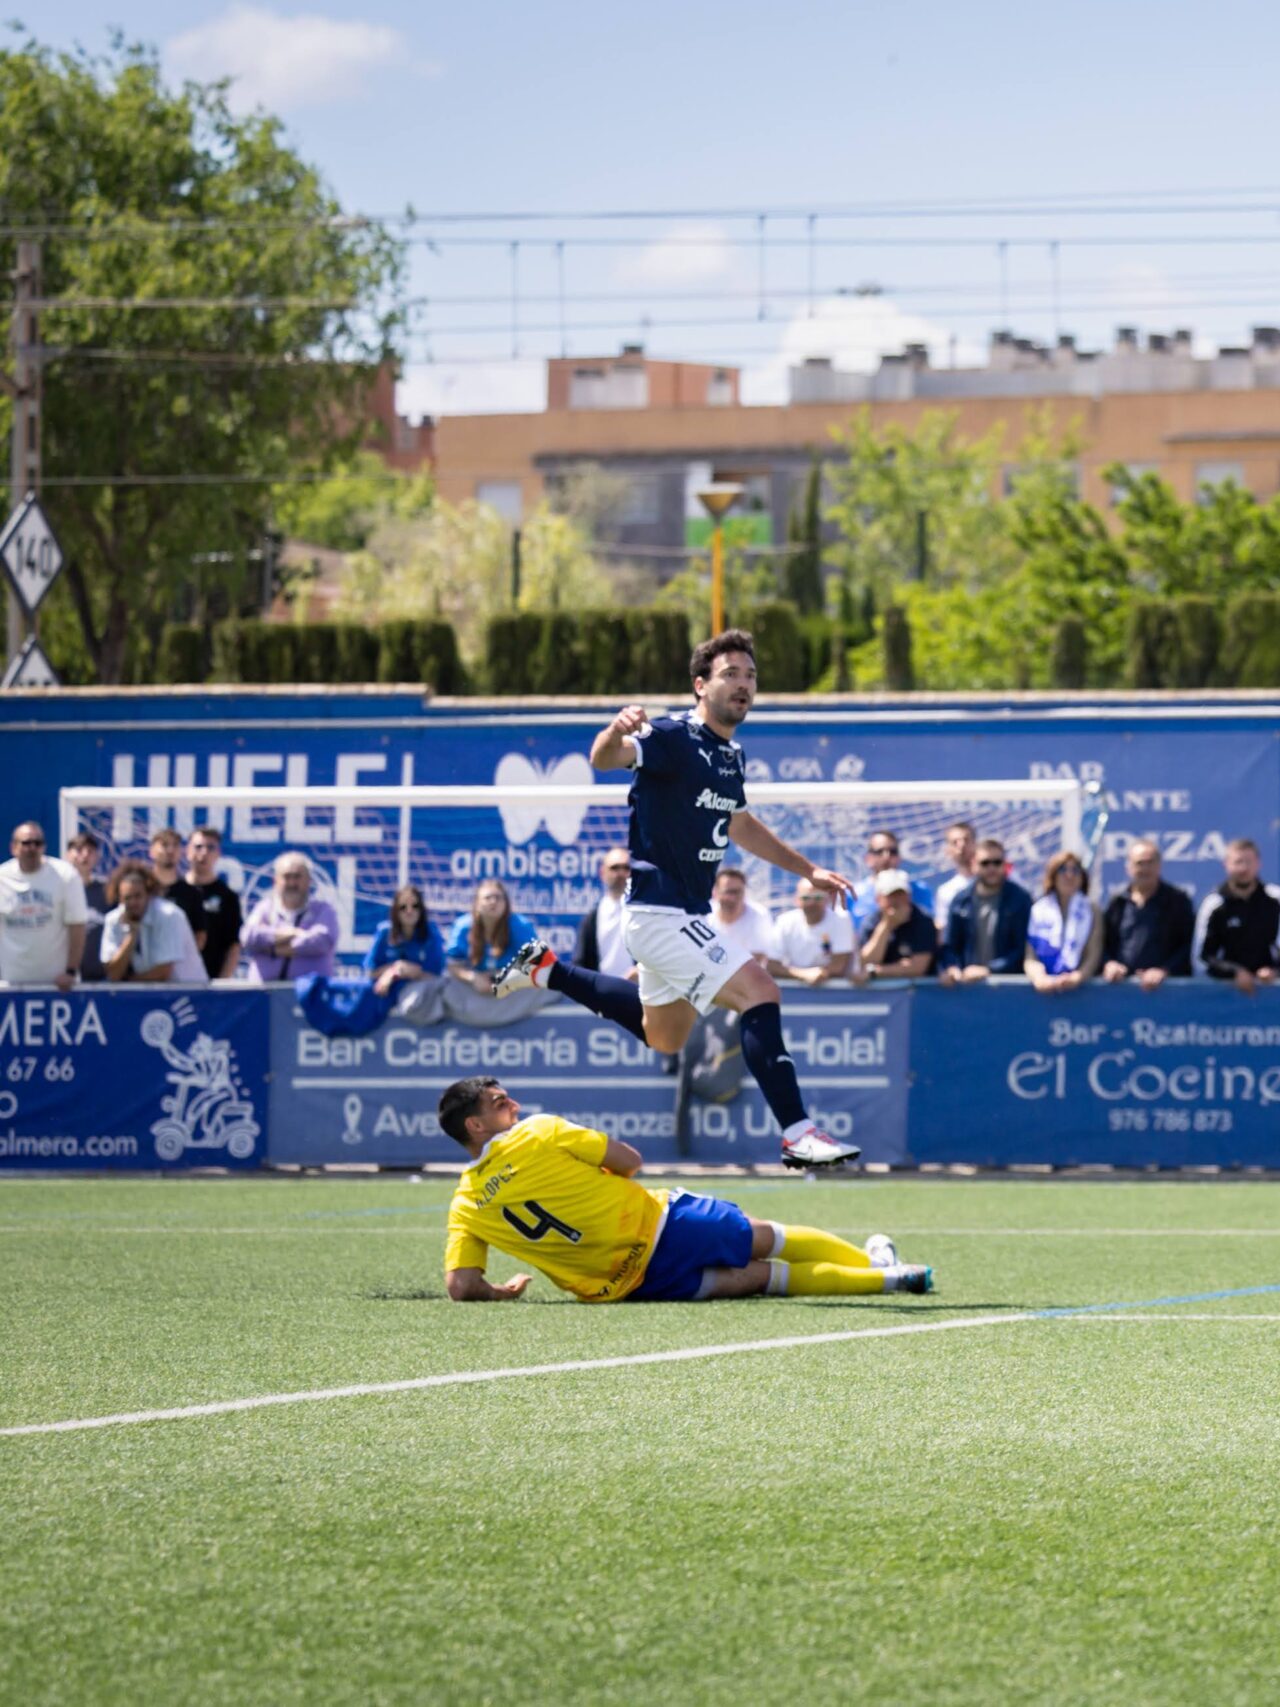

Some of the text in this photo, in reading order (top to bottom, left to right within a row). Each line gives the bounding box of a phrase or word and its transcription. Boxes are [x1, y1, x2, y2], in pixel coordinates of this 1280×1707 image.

[16, 536, 53, 579] 140
[680, 920, 716, 948] 10
[297, 1030, 376, 1067] Bar
[384, 1028, 577, 1068] Cafetería
[1049, 1018, 1105, 1047] Bar
[7, 1057, 75, 1082] 67 66
[1007, 1052, 1067, 1100] El
[1108, 1108, 1148, 1132] 976
[503, 1200, 582, 1243] 4
